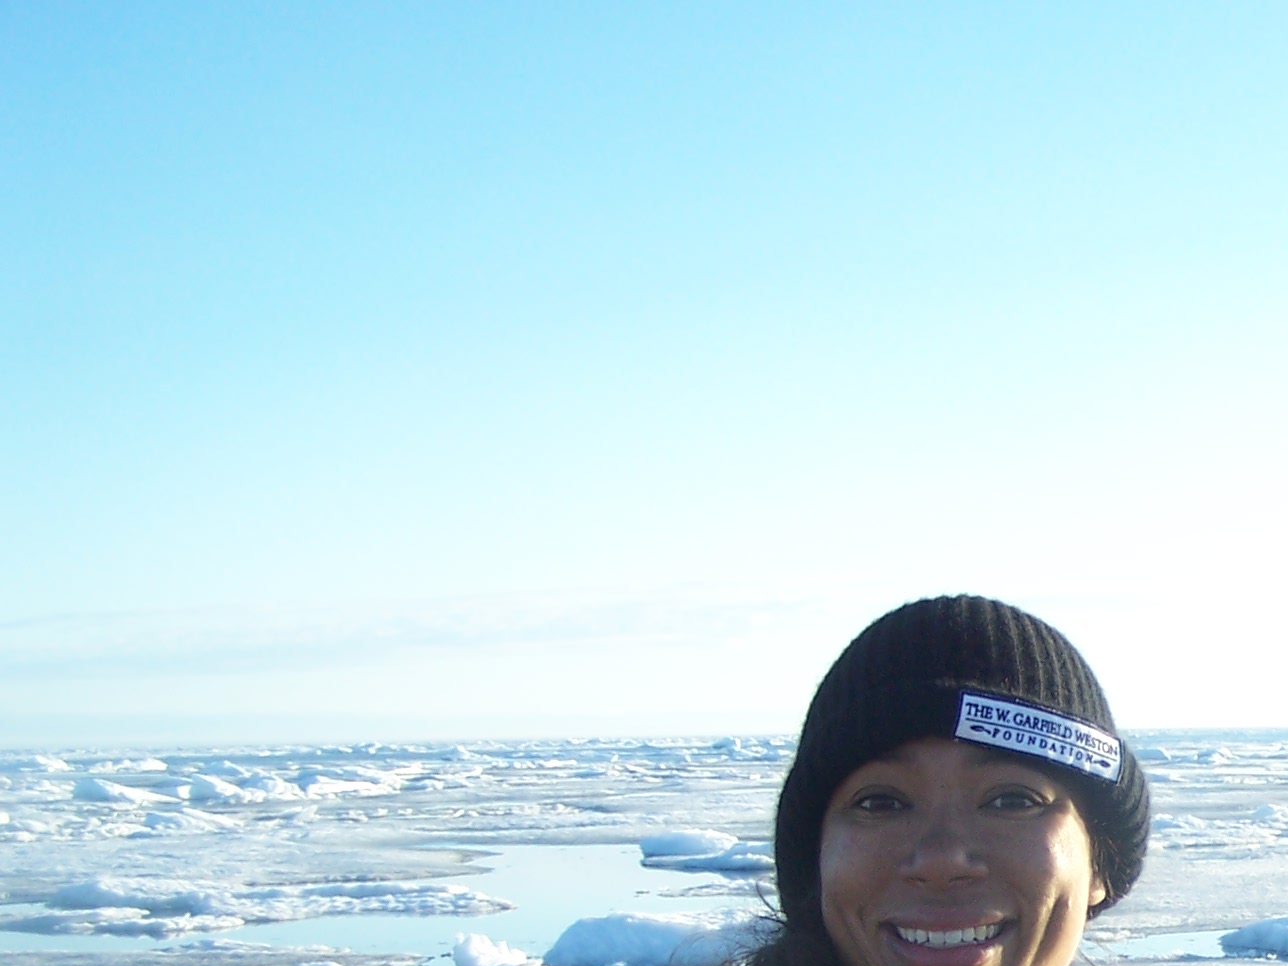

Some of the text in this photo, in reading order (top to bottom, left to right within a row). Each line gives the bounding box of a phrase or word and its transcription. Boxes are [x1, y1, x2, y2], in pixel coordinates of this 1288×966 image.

[965, 702, 1118, 757] THE W. GARFIELD WESTON
[992, 729, 1093, 762] FOUNDATION
